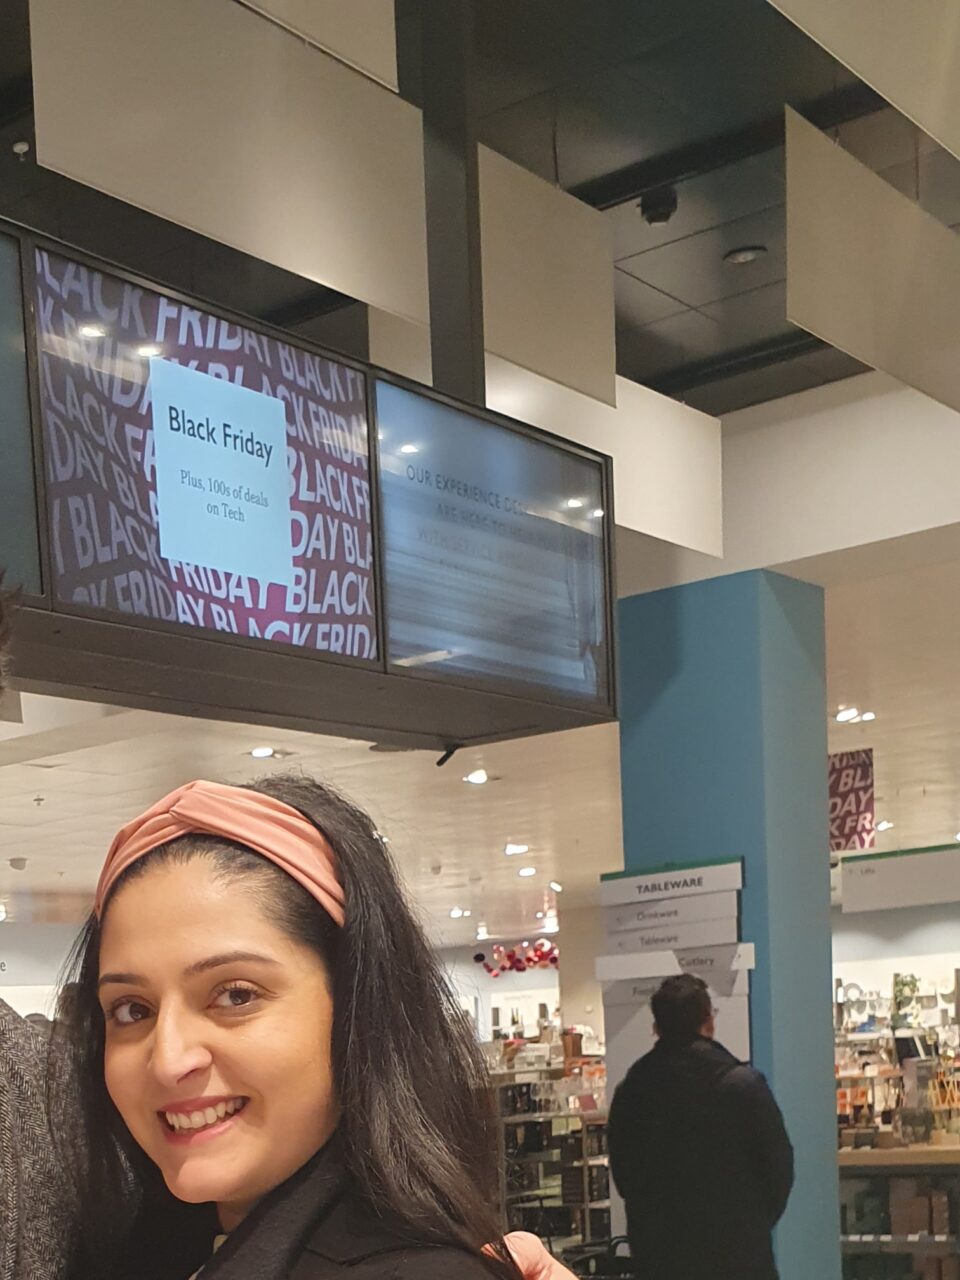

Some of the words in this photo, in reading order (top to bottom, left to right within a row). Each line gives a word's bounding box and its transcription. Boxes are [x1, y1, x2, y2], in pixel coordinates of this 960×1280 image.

[168, 404, 217, 445] Black
[222, 422, 273, 468] Friday
[180, 469, 206, 492] Plus,
[208, 477, 231, 498] 100s
[233, 485, 244, 501] of
[244, 487, 269, 508] deals
[406, 464, 432, 487] OUR
[435, 473, 501, 510] EXPERIENCE
[206, 502, 220, 516] on
[221, 502, 245, 522] Tech
[68, 493, 167, 576] BLACK
[285, 566, 373, 616] BLACK
[635, 876, 704, 895] TABLEWARE
[636, 909, 679, 922] Drinkware
[640, 935, 679, 947] Tableware
[679, 956, 714, 969] Cutlery
